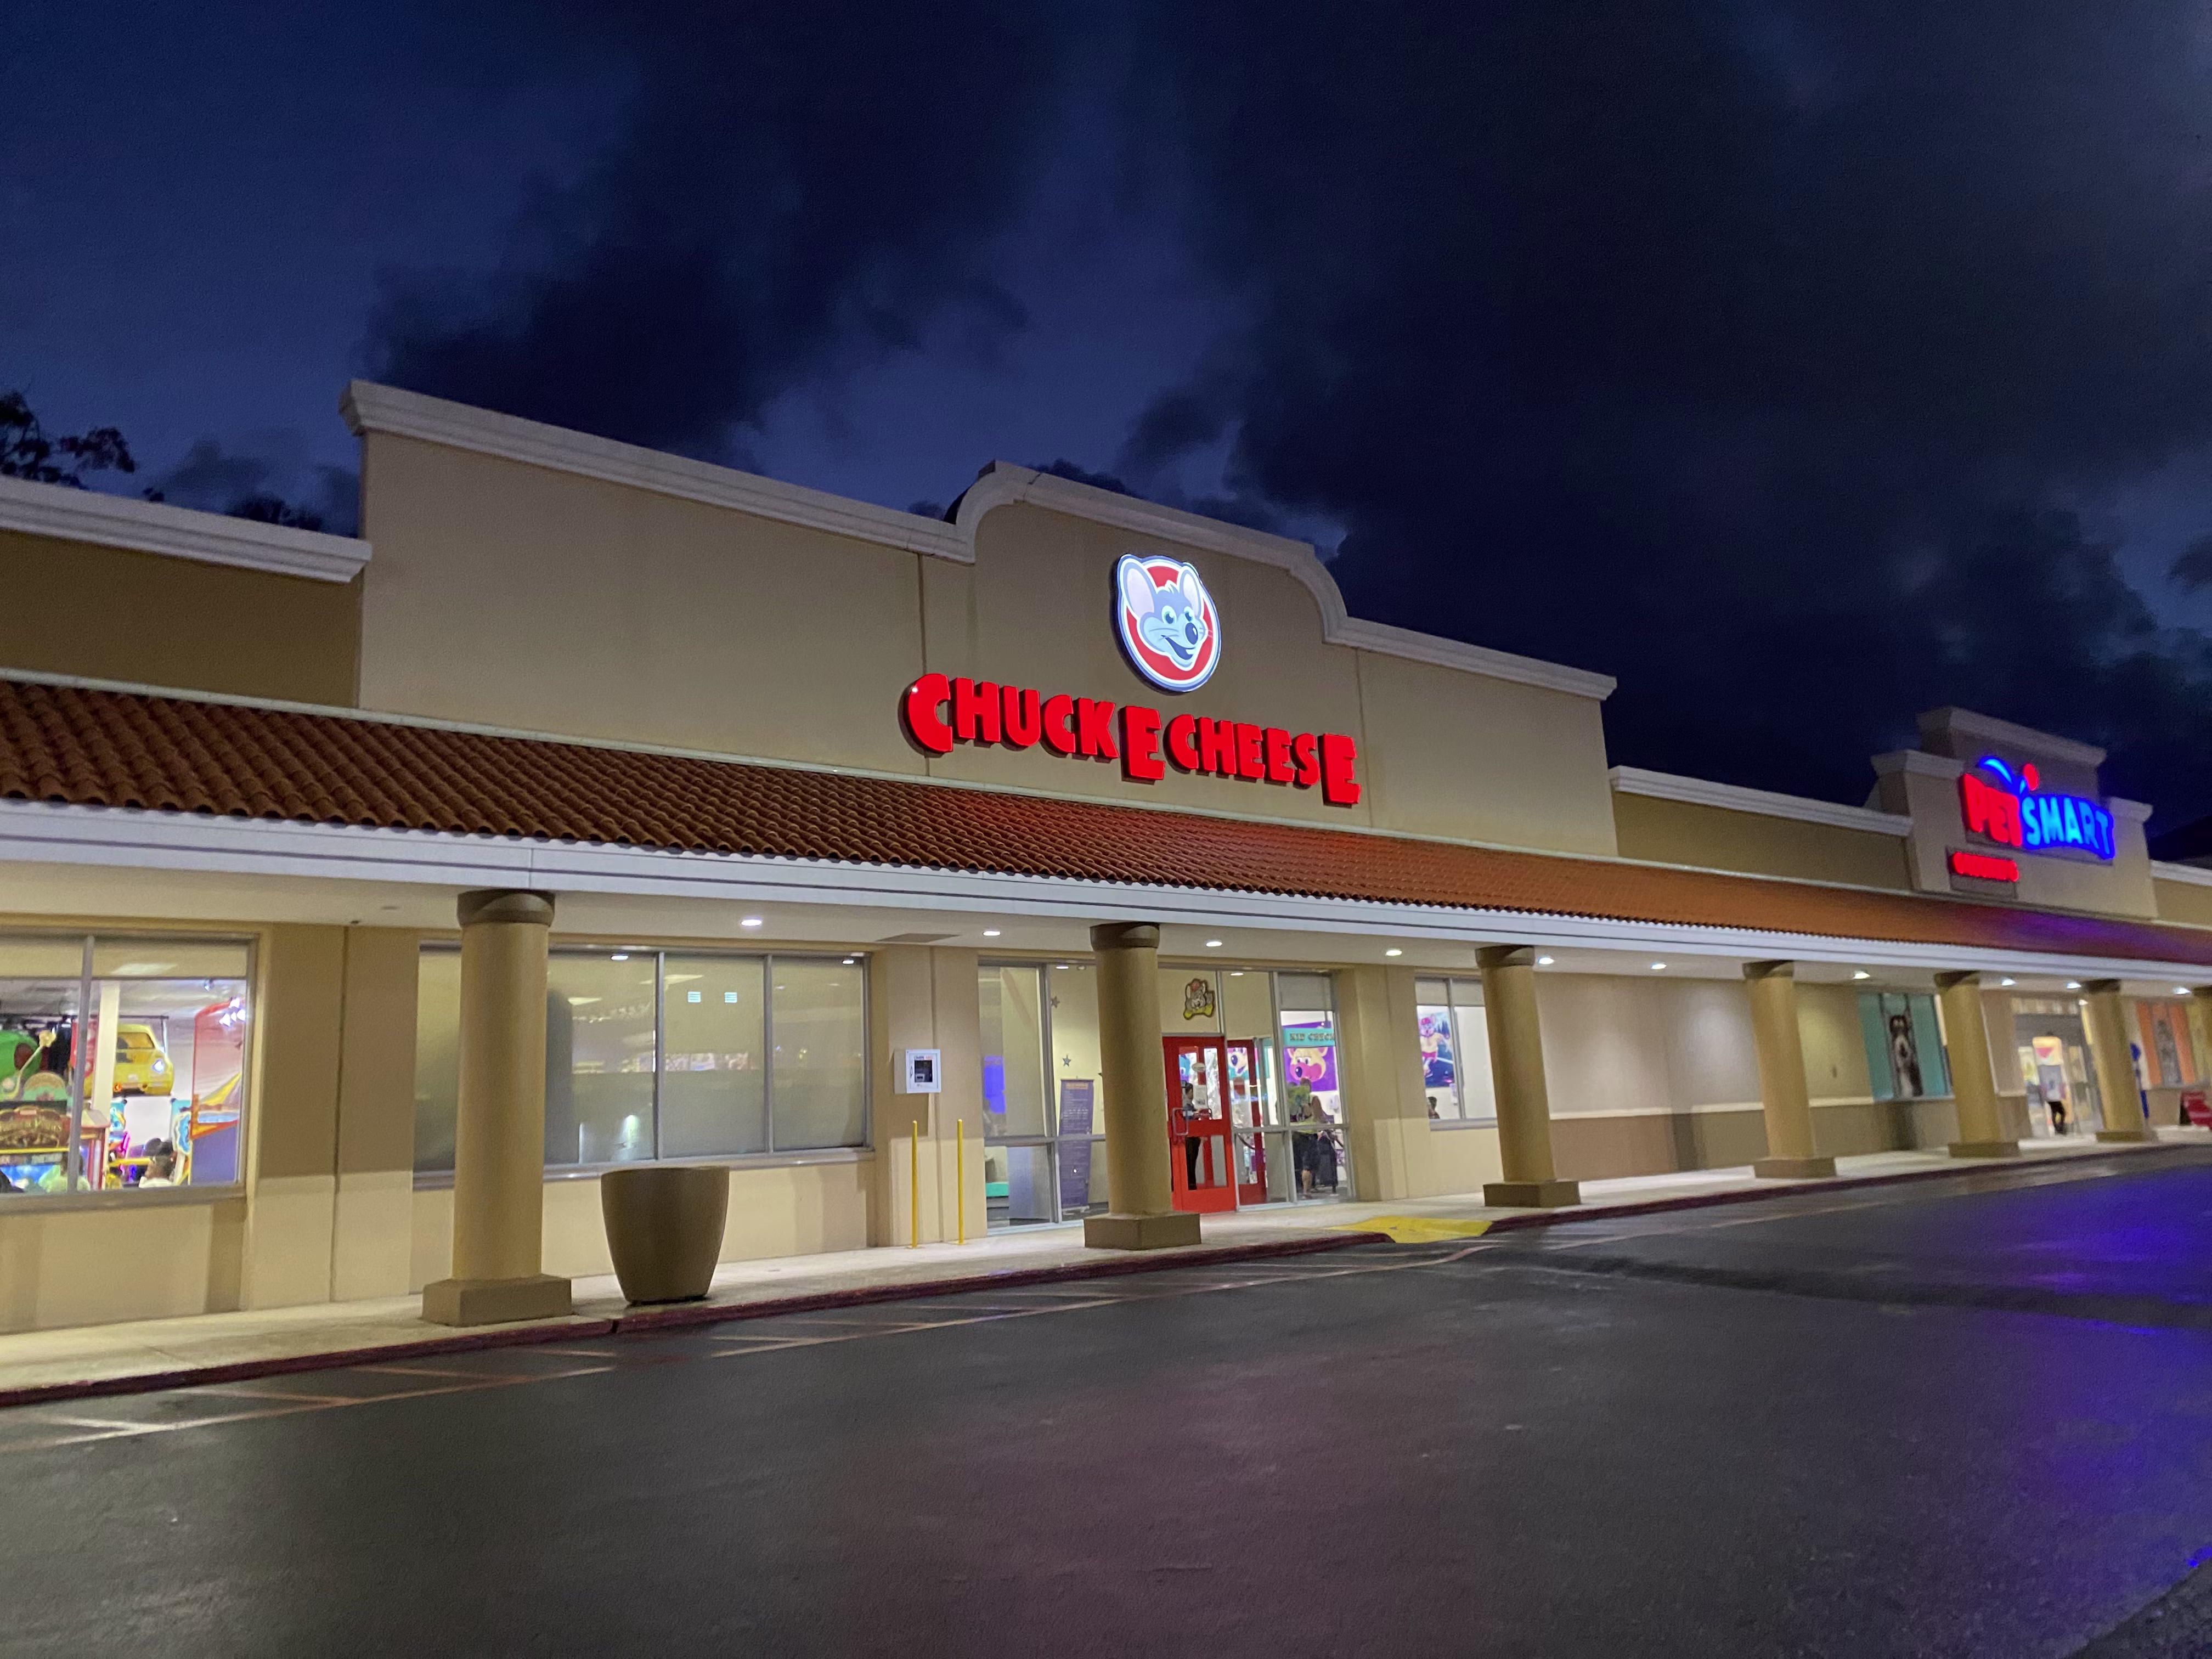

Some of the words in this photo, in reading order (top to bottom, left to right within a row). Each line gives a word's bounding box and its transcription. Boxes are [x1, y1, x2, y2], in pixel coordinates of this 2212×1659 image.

[904, 673, 1120, 759] CHUCK
[1124, 706, 1166, 780] E
[1169, 714, 1362, 804] CHEESE
